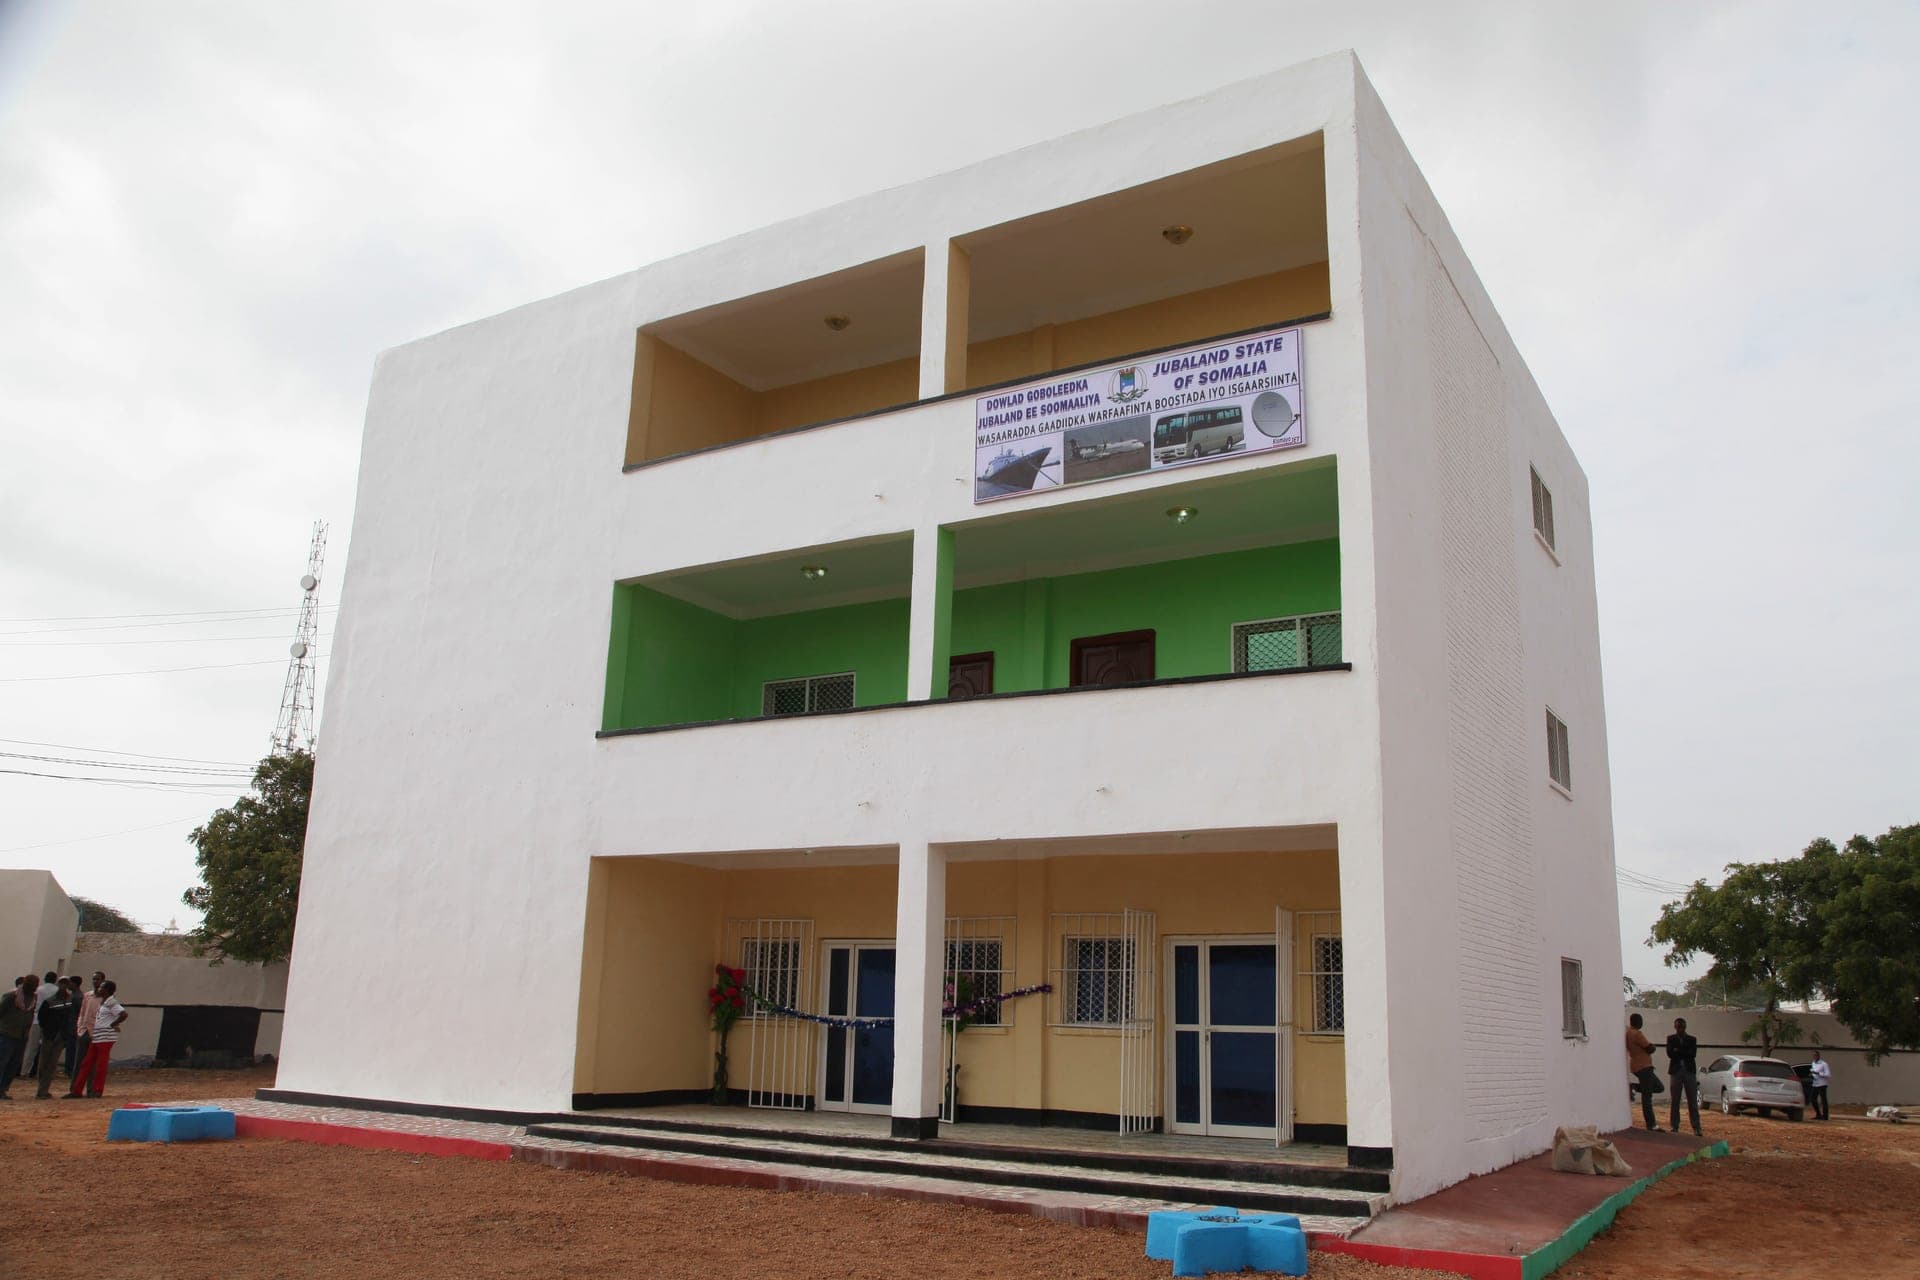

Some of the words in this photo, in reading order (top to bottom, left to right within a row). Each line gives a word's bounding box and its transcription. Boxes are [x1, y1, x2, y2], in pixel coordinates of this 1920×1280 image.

[1152, 349, 1229, 377] JUBALAND
[1236, 337, 1283, 359] STATE
[1174, 375, 1194, 390] OF
[1198, 360, 1267, 385] SOMALIA
[978, 425, 1036, 446] WASAARADDA
[1038, 415, 1086, 433] GAADIIDKA
[1088, 402, 1151, 421] WARFAAFINTA
[1155, 391, 1206, 409] BOOSTADA
[1208, 386, 1225, 399] IYO
[1228, 372, 1298, 395] ISGAARSIINTA
[978, 411, 1023, 429] JUBALAND
[1026, 406, 1038, 418] EE
[1040, 393, 1100, 413] SOOMAALIYA
[986, 394, 1024, 411] DOWLAD
[1027, 379, 1088, 400] GOBOLEEDKA
